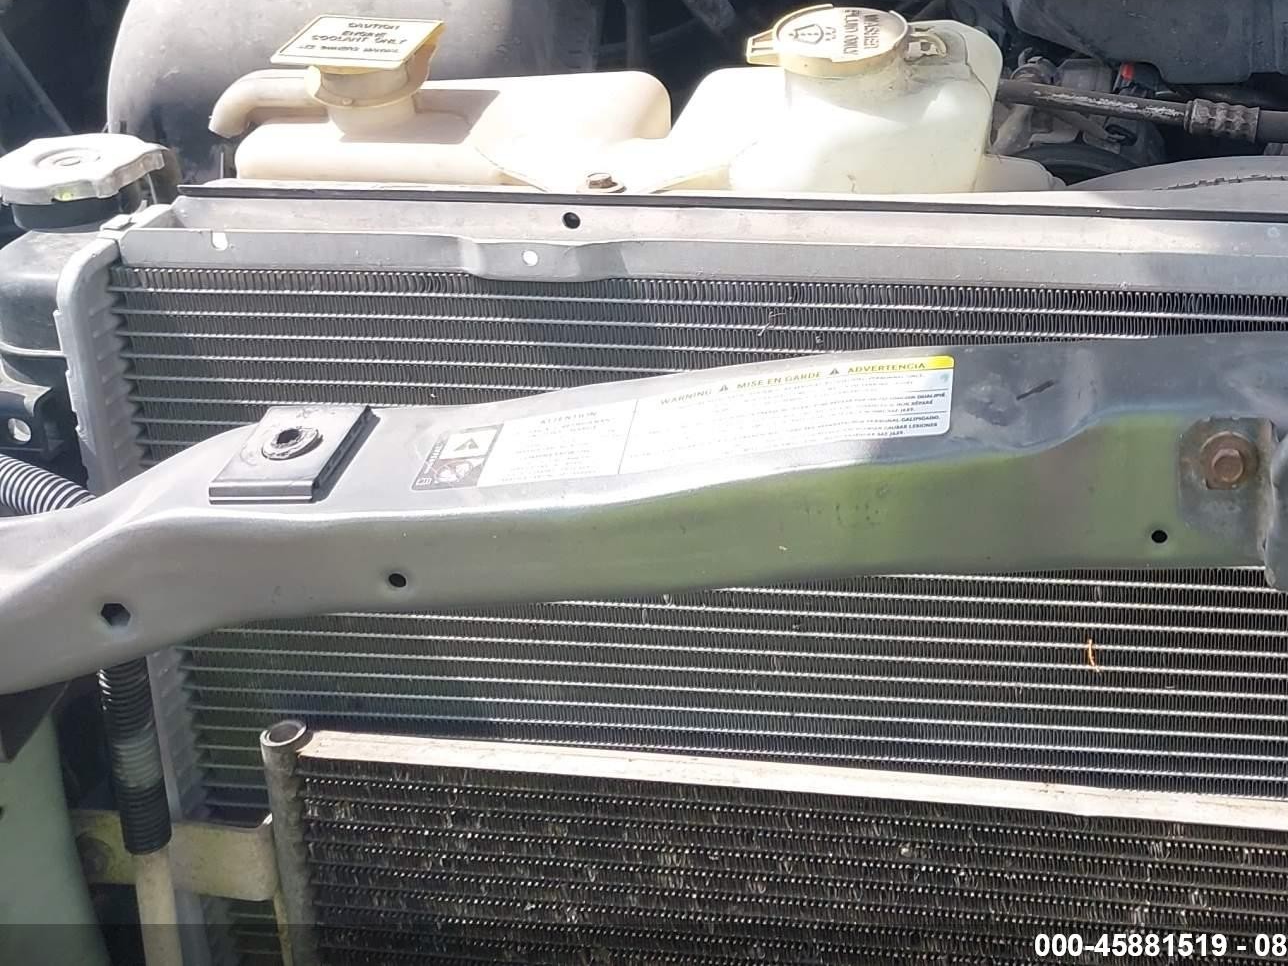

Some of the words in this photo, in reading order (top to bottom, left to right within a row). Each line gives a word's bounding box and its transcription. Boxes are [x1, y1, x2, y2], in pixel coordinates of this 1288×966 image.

[348, 22, 400, 30] CAUTION
[311, 34, 370, 44] COOLANT
[659, 389, 713, 405] WARNING
[736, 379, 765, 389] MISE
[767, 376, 782, 385] EN
[784, 371, 821, 382] GARDE
[848, 362, 926, 374] ADVERTENCIA
